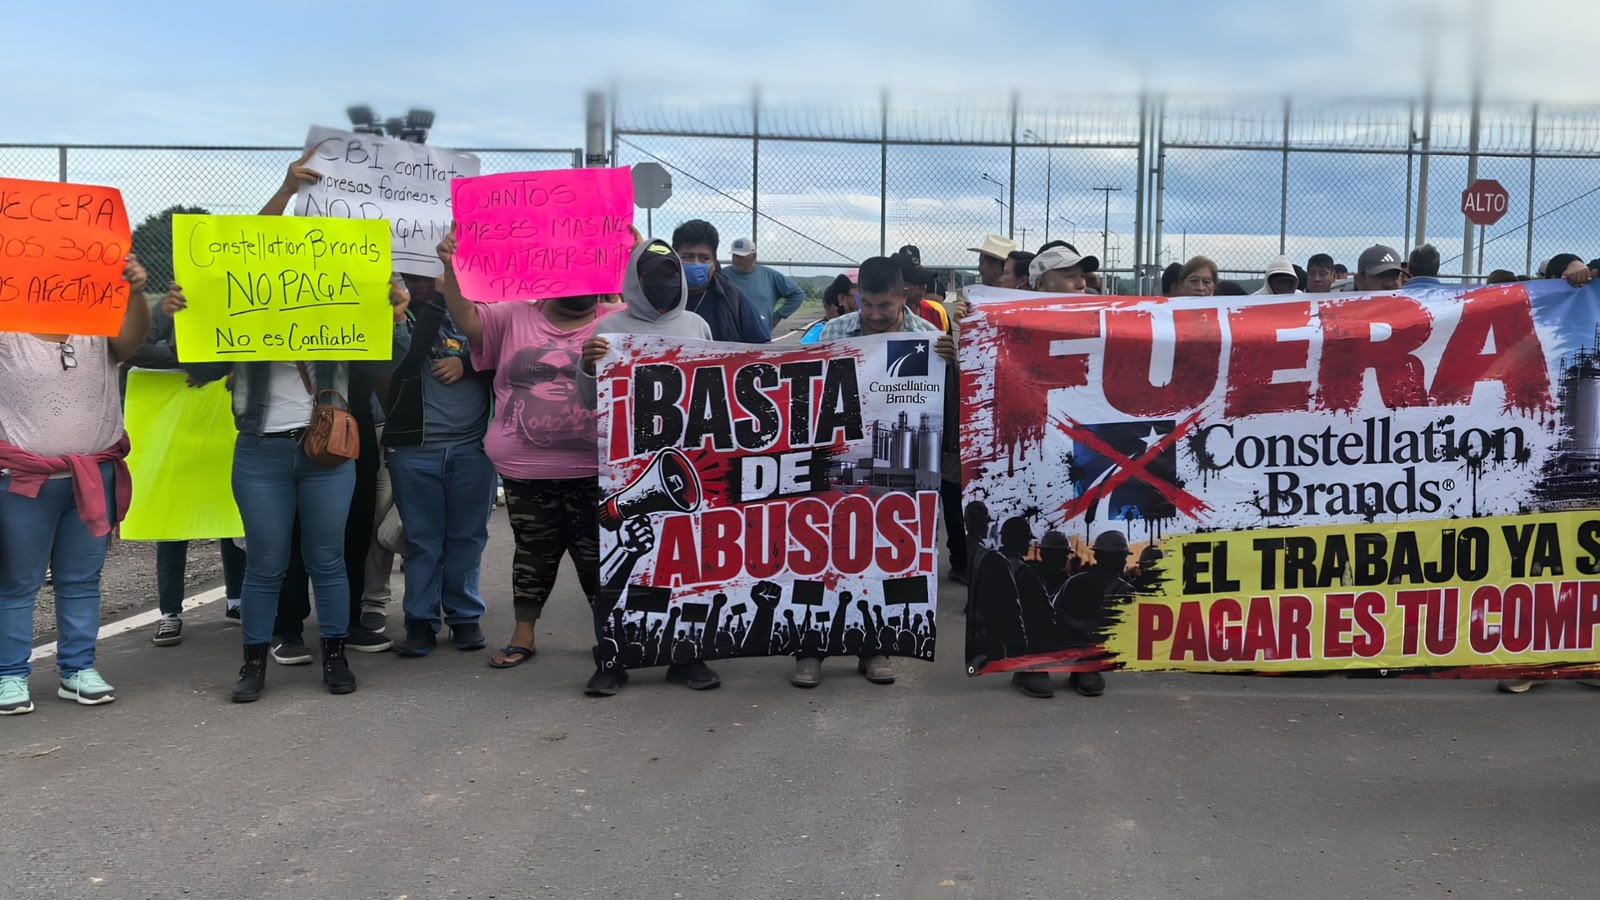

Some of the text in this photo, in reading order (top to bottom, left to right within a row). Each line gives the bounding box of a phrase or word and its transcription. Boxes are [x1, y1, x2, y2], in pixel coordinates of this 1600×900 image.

[313, 137, 384, 169] CBI
[454, 178, 576, 214] CUANTOS
[1464, 192, 1506, 212] ALTO
[189, 221, 381, 270] Constellation Brands
[459, 219, 538, 245] MESES
[552, 217, 600, 240] MAS
[55, 237, 122, 266] 300
[456, 252, 497, 276] VAN
[506, 252, 518, 272] A
[520, 244, 577, 272] TENER
[27, 273, 126, 311] AFECTADAS
[226, 269, 360, 308] NO PAGA
[490, 276, 574, 297] PAGO
[216, 322, 366, 351] No es Confiable
[994, 283, 1554, 432] FUERA
[869, 380, 940, 393] Constellation
[609, 357, 865, 464] ¡BASTA
[1200, 414, 1525, 471] Constellation
[740, 452, 813, 501] DE
[651, 490, 939, 588] ABUSOS!
[1182, 541, 1241, 595] EL
[1252, 526, 1490, 591] TRABAJO
[1501, 522, 1564, 578] YA
[1137, 594, 1313, 662] PAGAR
[1323, 591, 1387, 659] ES
[1396, 586, 1460, 657] TU
